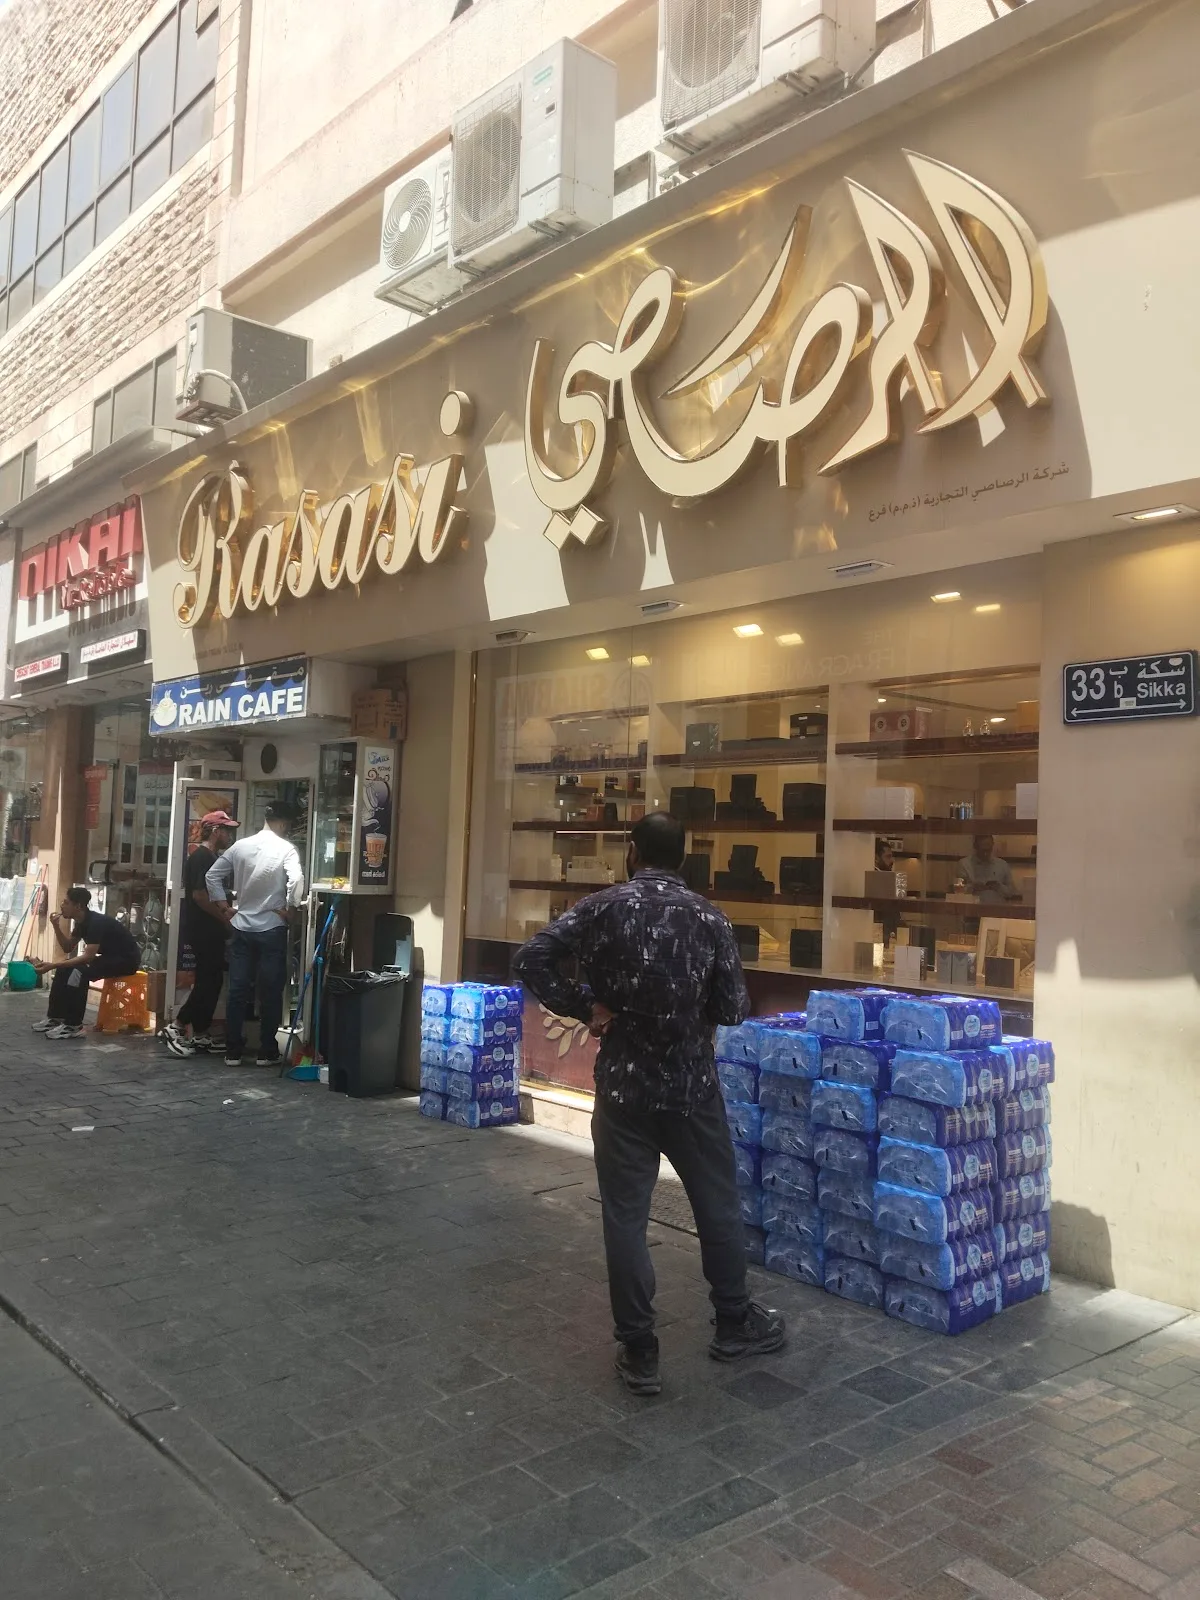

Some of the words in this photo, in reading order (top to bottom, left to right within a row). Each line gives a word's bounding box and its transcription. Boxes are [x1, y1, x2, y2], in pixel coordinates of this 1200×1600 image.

[524, 149, 1049, 550] الرصاصي
[1032, 462, 1070, 481] شركة
[923, 486, 968, 508] التجارية
[971, 472, 1029, 501] الرصاصي
[173, 389, 471, 629] Rasasi
[868, 505, 887, 522] فرع
[1109, 665, 1129, 679] ب
[1137, 660, 1186, 679] سكة
[1071, 667, 1106, 702] 33
[1114, 680, 1124, 699] b
[1136, 680, 1186, 699] Sikka
[178, 697, 231, 727] RAIN
[237, 686, 304, 718] CAFE
